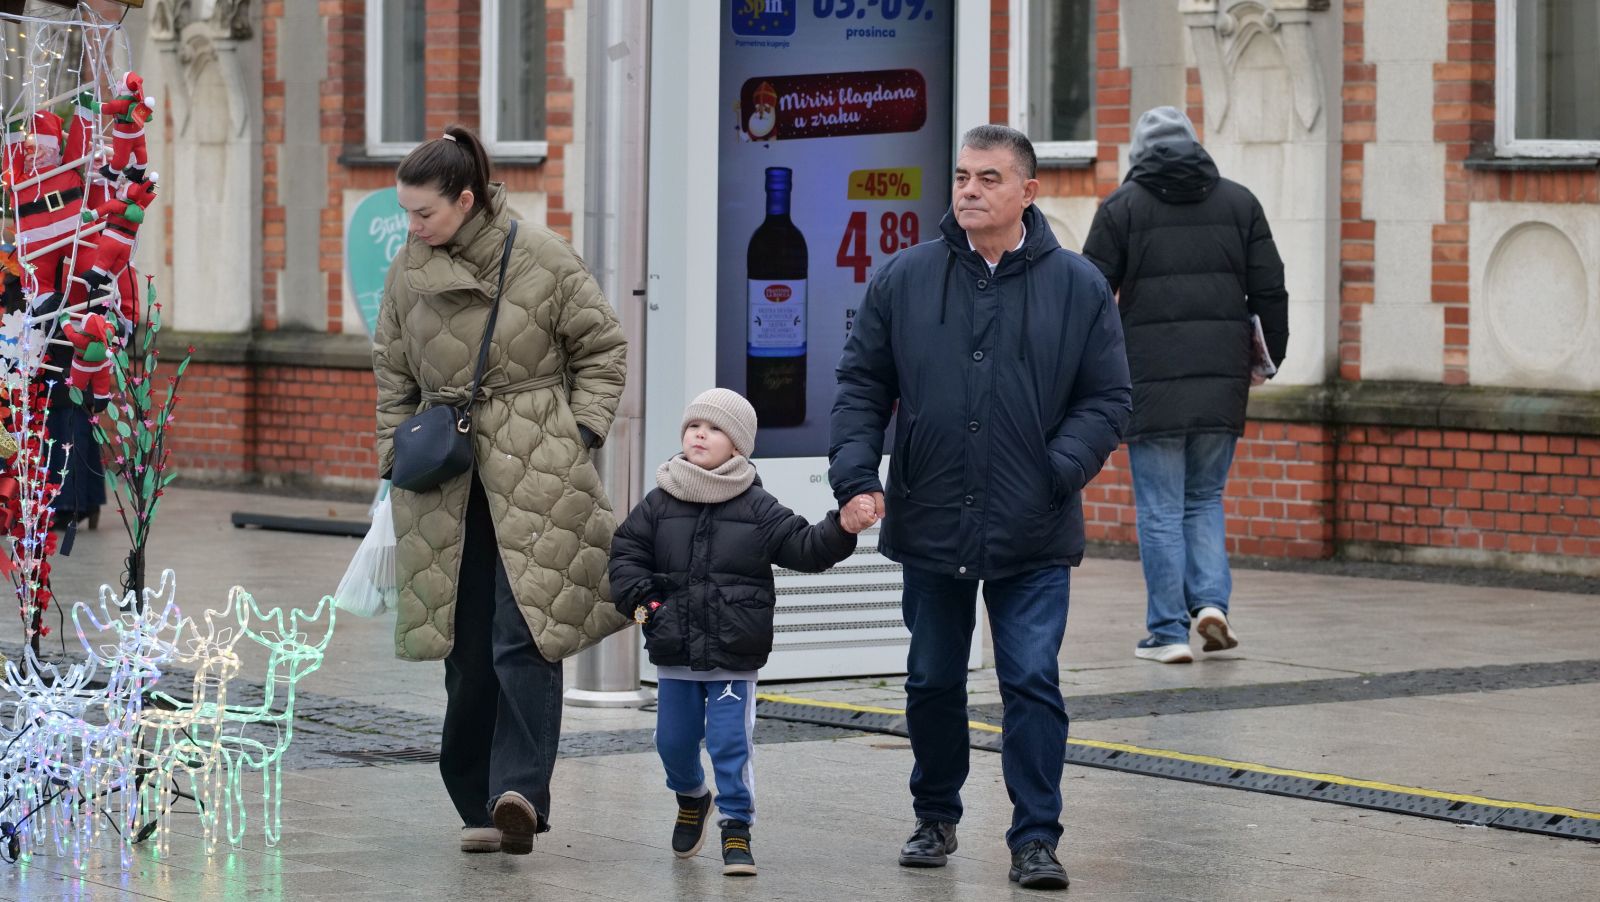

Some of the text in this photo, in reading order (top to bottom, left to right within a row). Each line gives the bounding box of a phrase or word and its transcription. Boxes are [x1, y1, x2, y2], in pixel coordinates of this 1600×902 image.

[743, 0, 784, 19] Spin
[846, 26, 896, 40] prosinca
[780, 83, 917, 111] Mirisi blagdana
[794, 106, 861, 128] u zraku
[856, 173, 910, 196] -45%
[836, 211, 920, 283] 4 89
